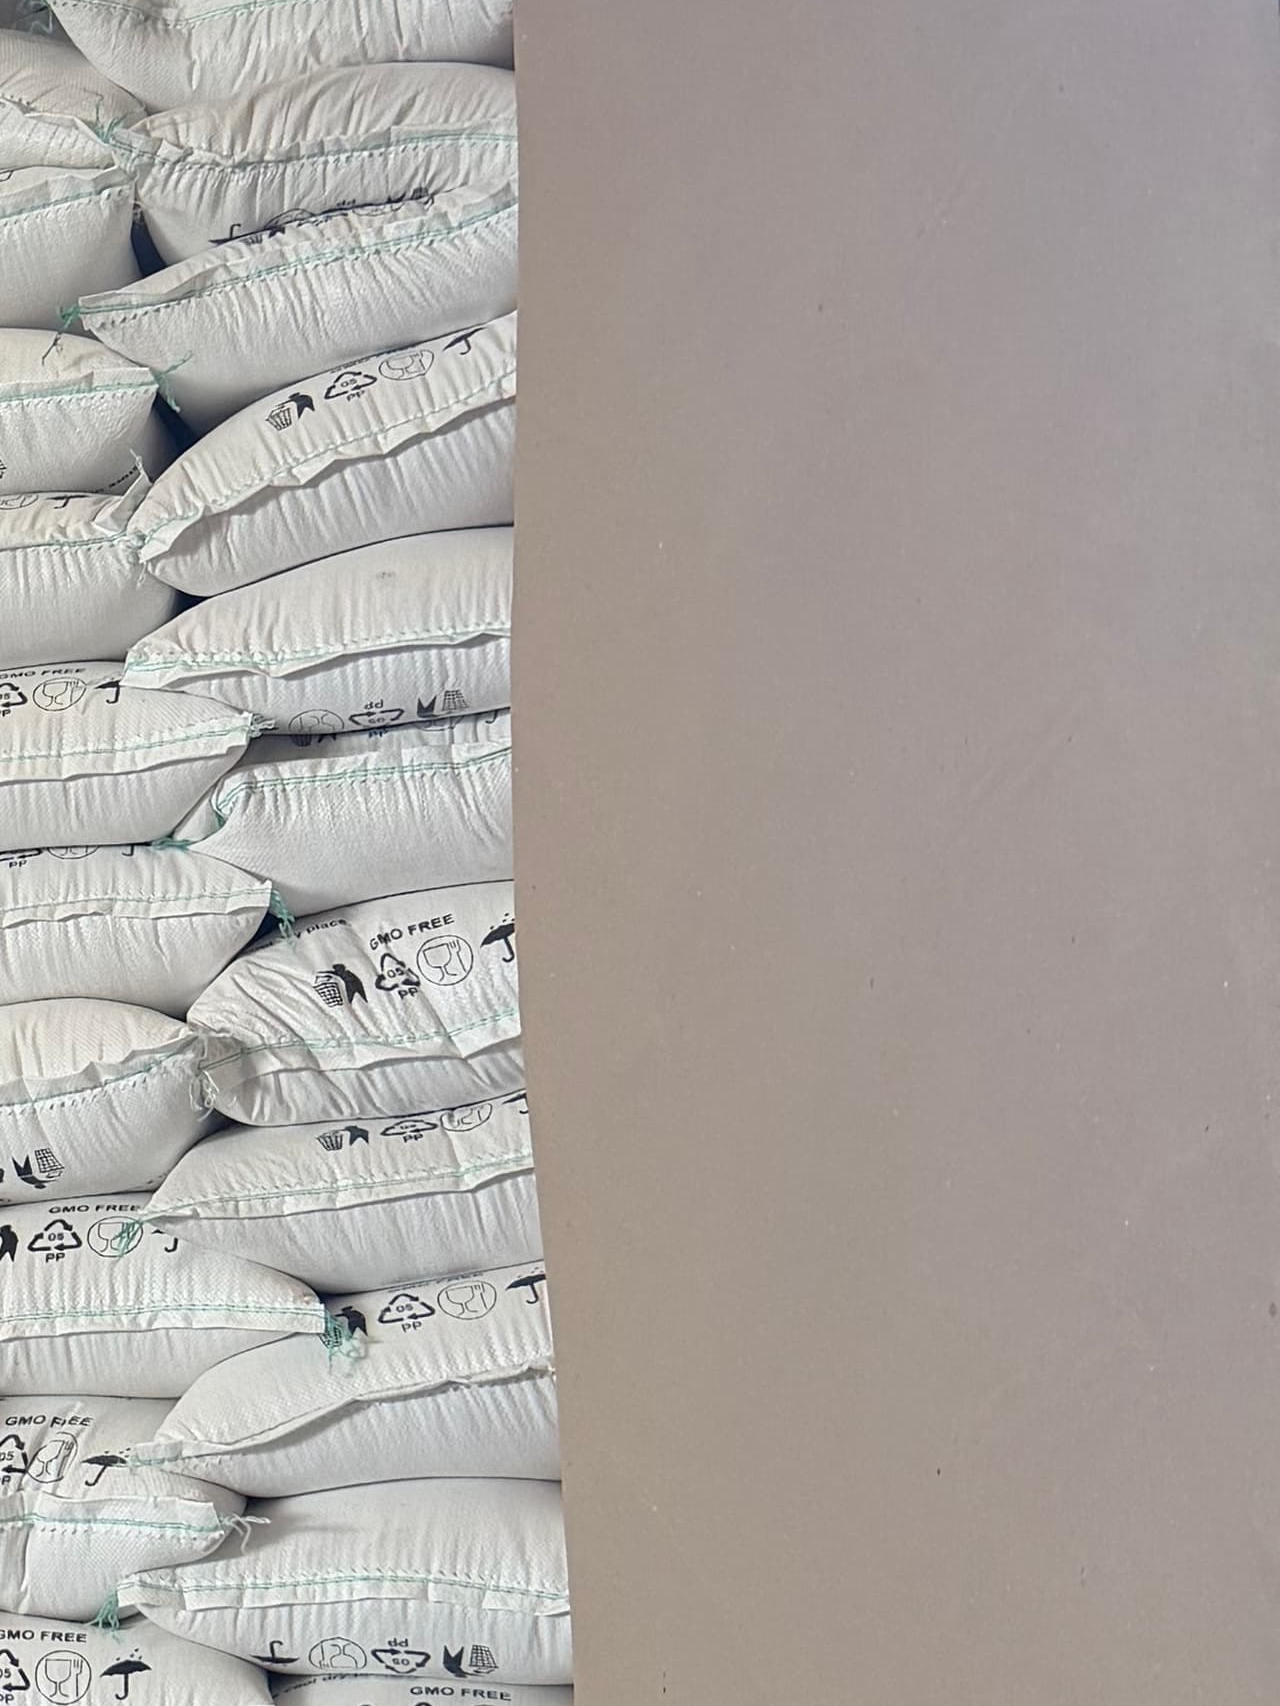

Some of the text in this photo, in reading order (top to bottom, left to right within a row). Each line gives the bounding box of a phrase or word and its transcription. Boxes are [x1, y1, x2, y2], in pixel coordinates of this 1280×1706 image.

[42, 668, 86, 677] FREE
[364, 700, 384, 709] PP
[10, 860, 26, 868] PP
[370, 913, 455, 950] GMO FREE
[399, 986, 420, 998] PP
[404, 1132, 424, 1143] PP
[49, 1203, 141, 1213] GMO FREE
[46, 1252, 65, 1263] PP
[396, 1305, 414, 1314] 05
[402, 1321, 423, 1333] PP
[5, 1415, 46, 1426] GMO
[40, 1630, 87, 1643] FREE
[388, 1638, 409, 1648] PP
[411, 1686, 512, 1701] GMO FREE
